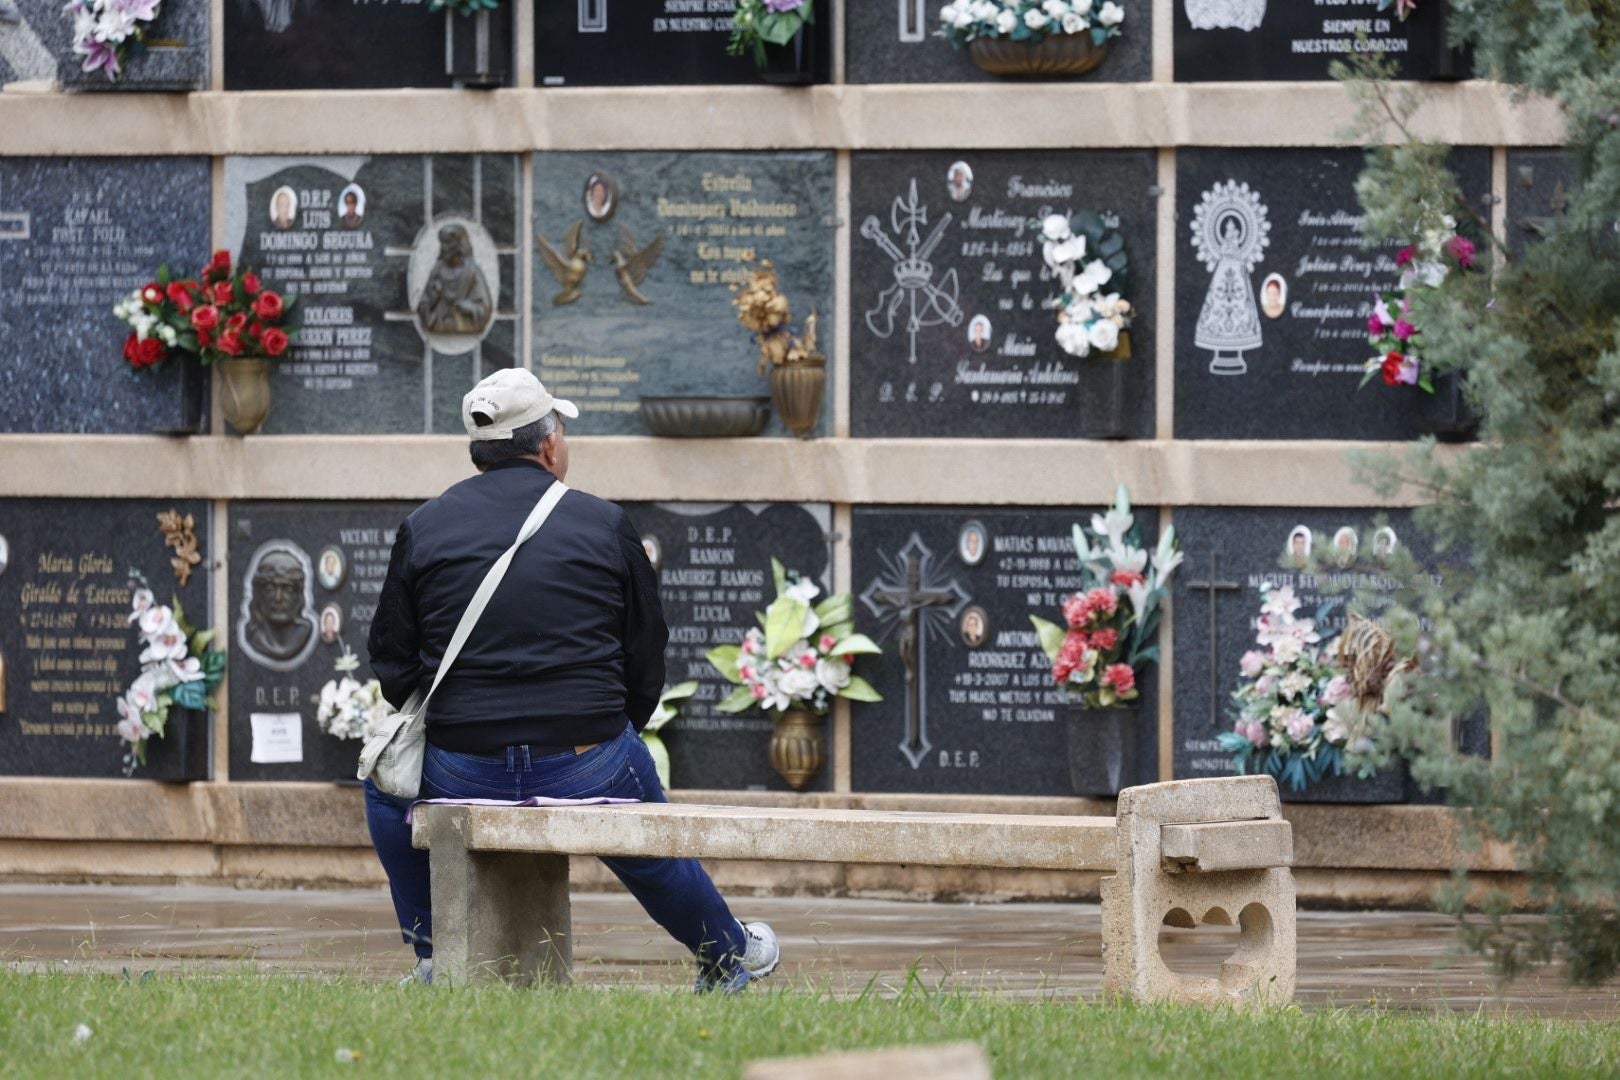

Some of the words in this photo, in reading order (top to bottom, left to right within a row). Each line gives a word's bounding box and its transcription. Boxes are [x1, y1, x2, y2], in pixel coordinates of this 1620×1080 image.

[1322, 19, 1372, 33] SIEMPRE
[1375, 19, 1390, 33] EN
[303, 210, 331, 229] LUIS
